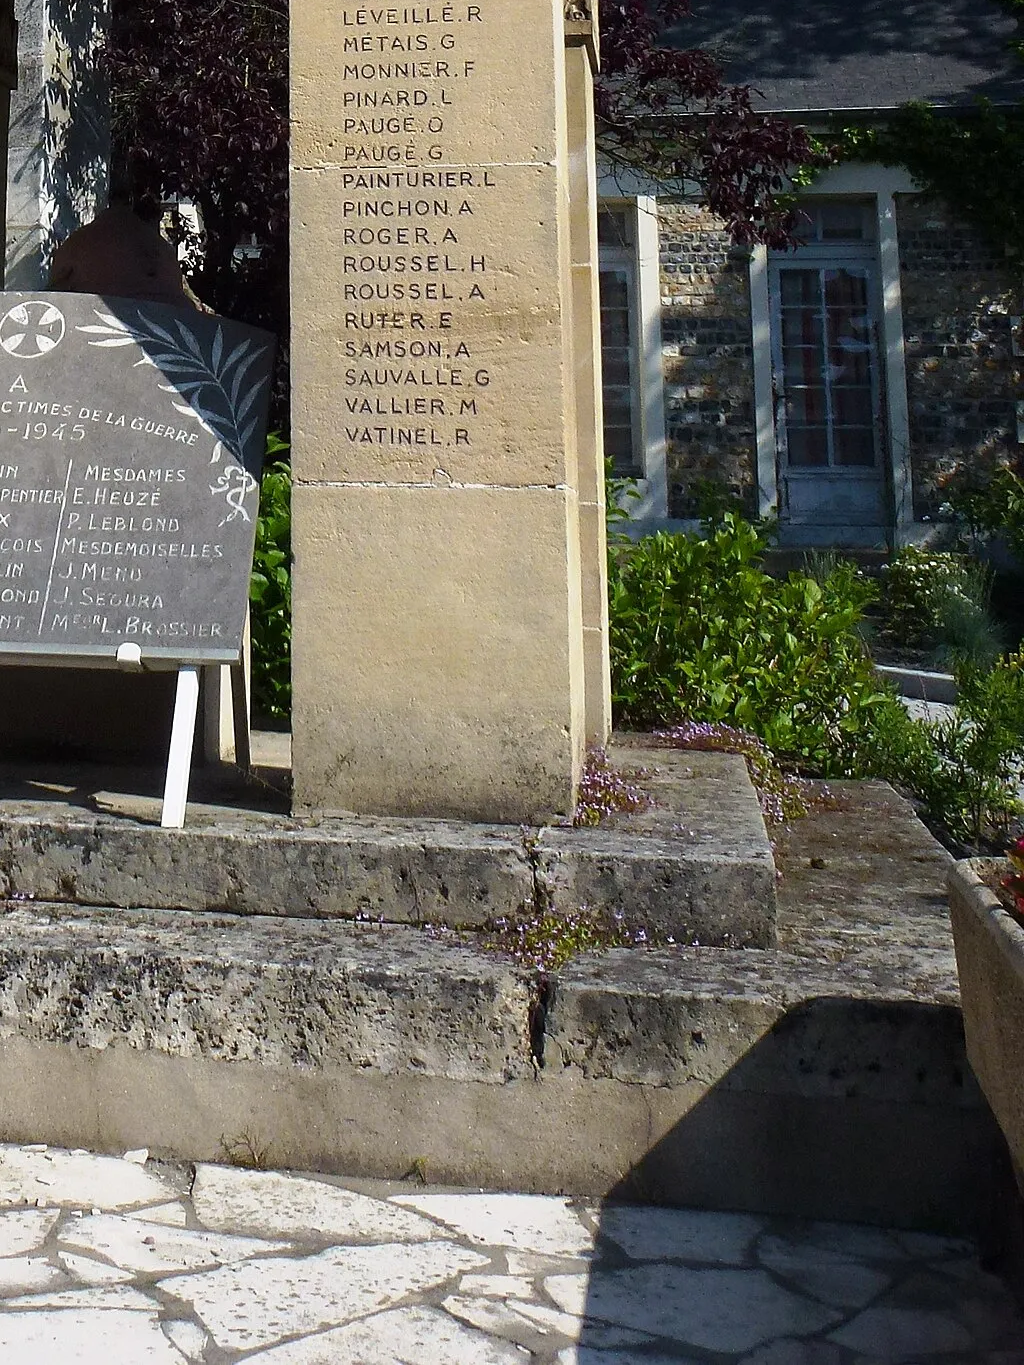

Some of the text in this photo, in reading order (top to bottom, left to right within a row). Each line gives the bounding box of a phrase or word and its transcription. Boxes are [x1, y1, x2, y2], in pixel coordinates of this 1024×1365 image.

[9, 374, 28, 393] A
[78, 407, 104, 422] DE
[105, 412, 126, 427] LA
[131, 415, 200, 447] GUERRE
[84, 464, 186, 482] MESDAMES
[61, 537, 223, 558] MESDEMOISELLES
